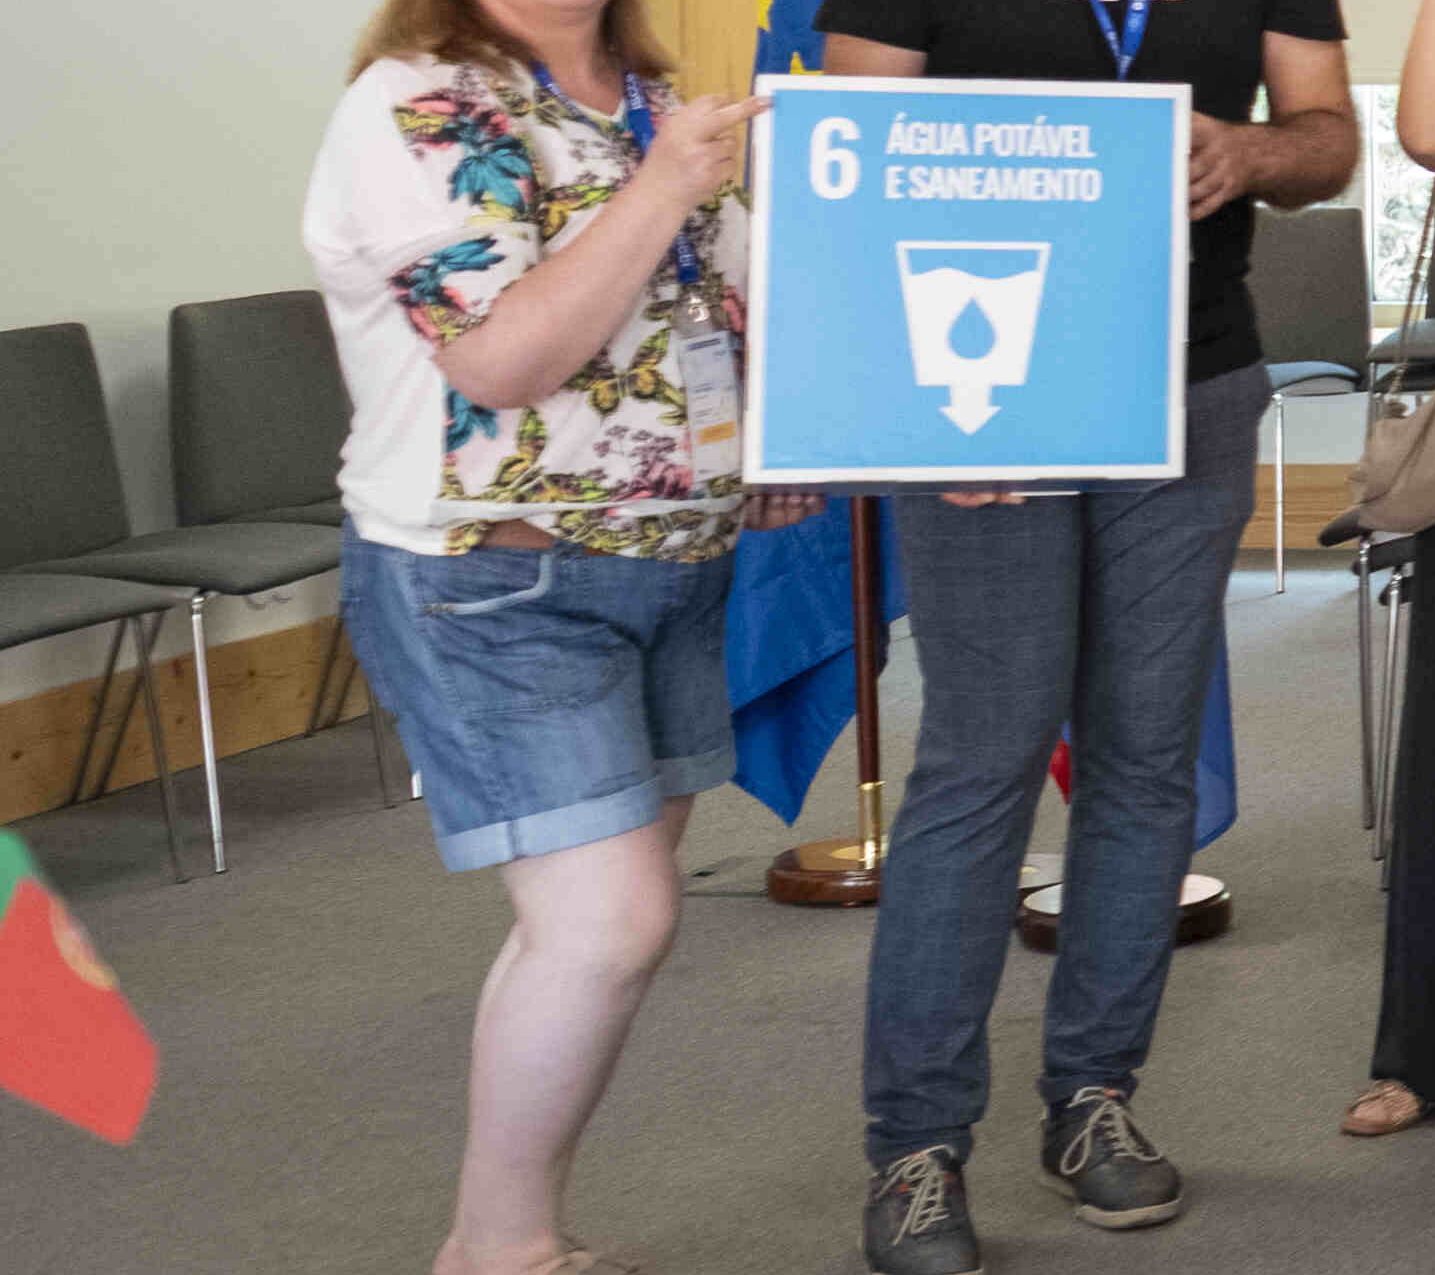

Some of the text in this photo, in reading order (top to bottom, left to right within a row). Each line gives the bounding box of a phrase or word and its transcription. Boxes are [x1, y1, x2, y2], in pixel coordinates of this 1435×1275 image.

[809, 115, 861, 200] 6
[885, 111, 1097, 159] ÁGUA POTÁVEL
[884, 165, 1103, 202] E SANEAMENTO
